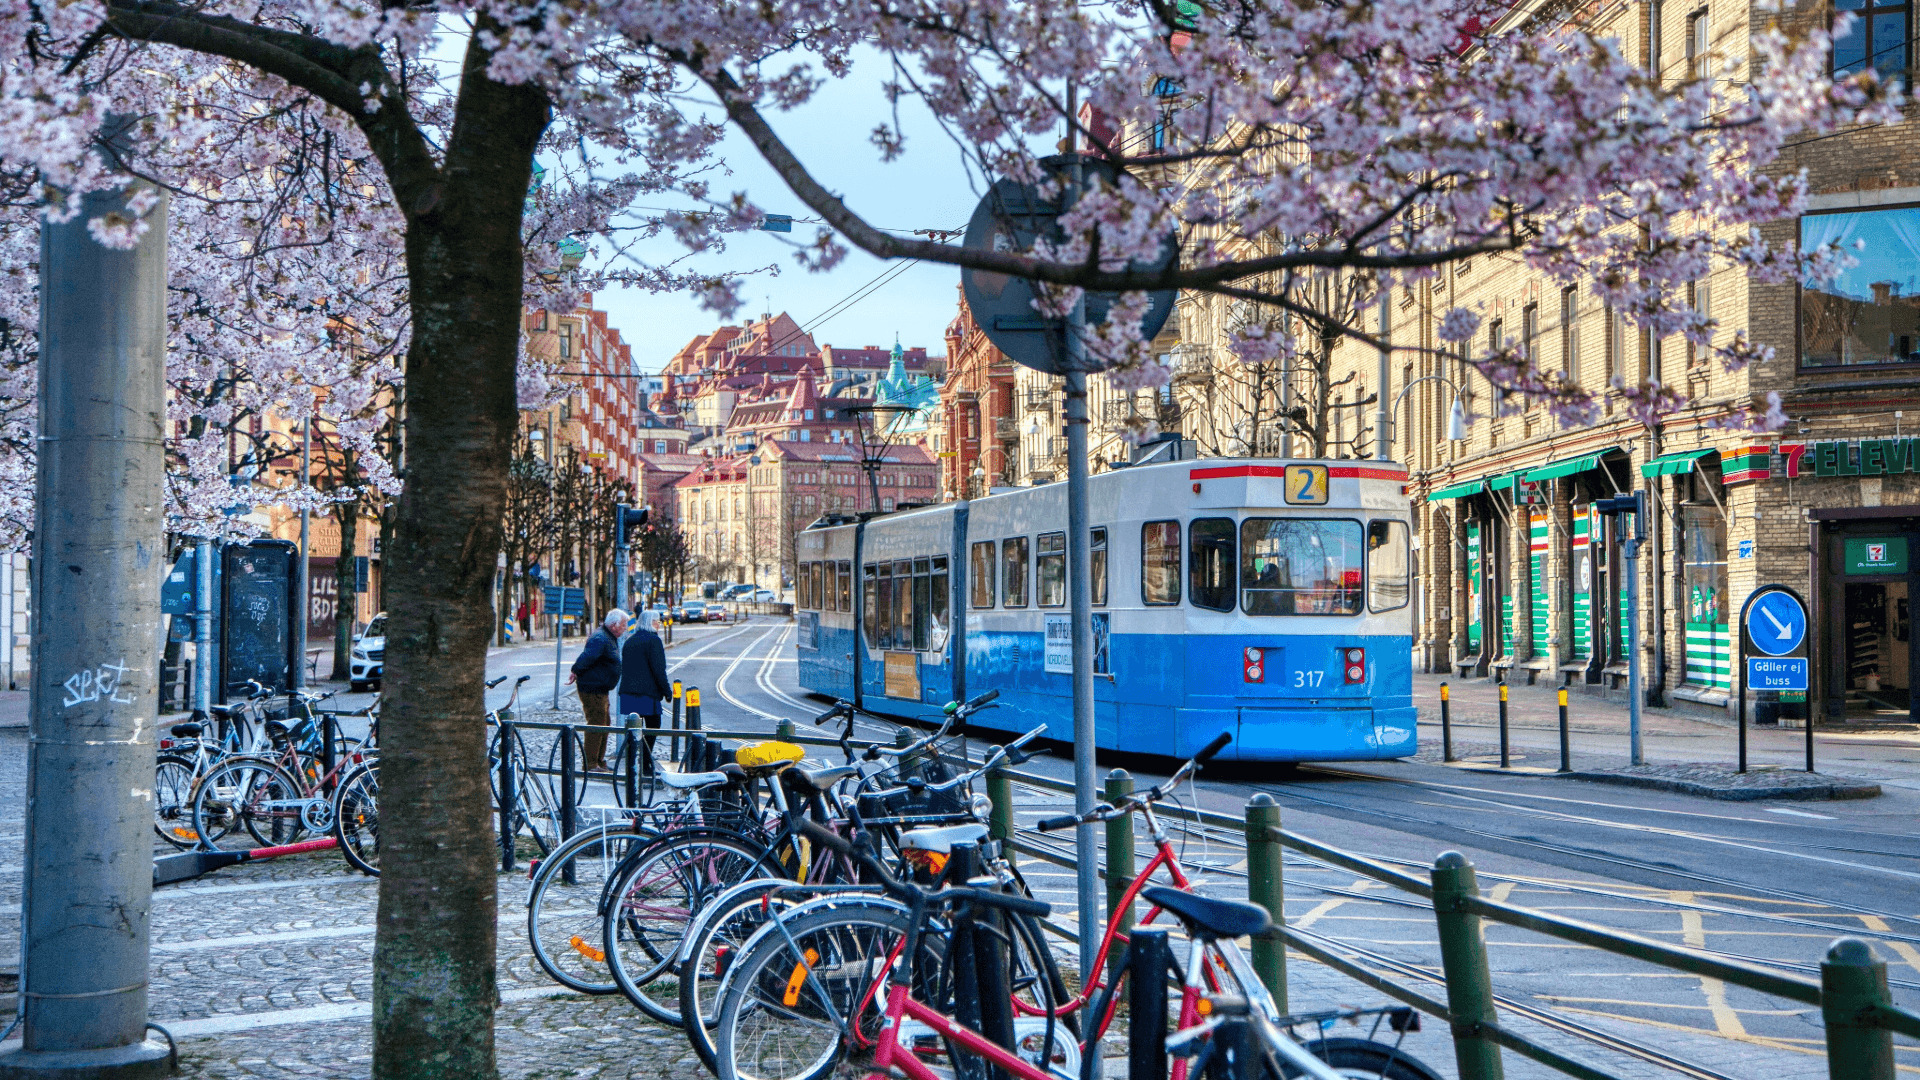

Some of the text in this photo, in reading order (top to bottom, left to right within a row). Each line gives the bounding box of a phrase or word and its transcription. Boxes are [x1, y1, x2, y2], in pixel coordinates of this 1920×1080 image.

[1297, 468, 1315, 500] 2
[1754, 661, 1801, 674] Gäller ej
[1294, 670, 1324, 688] 317
[1765, 675, 1790, 686] buss
